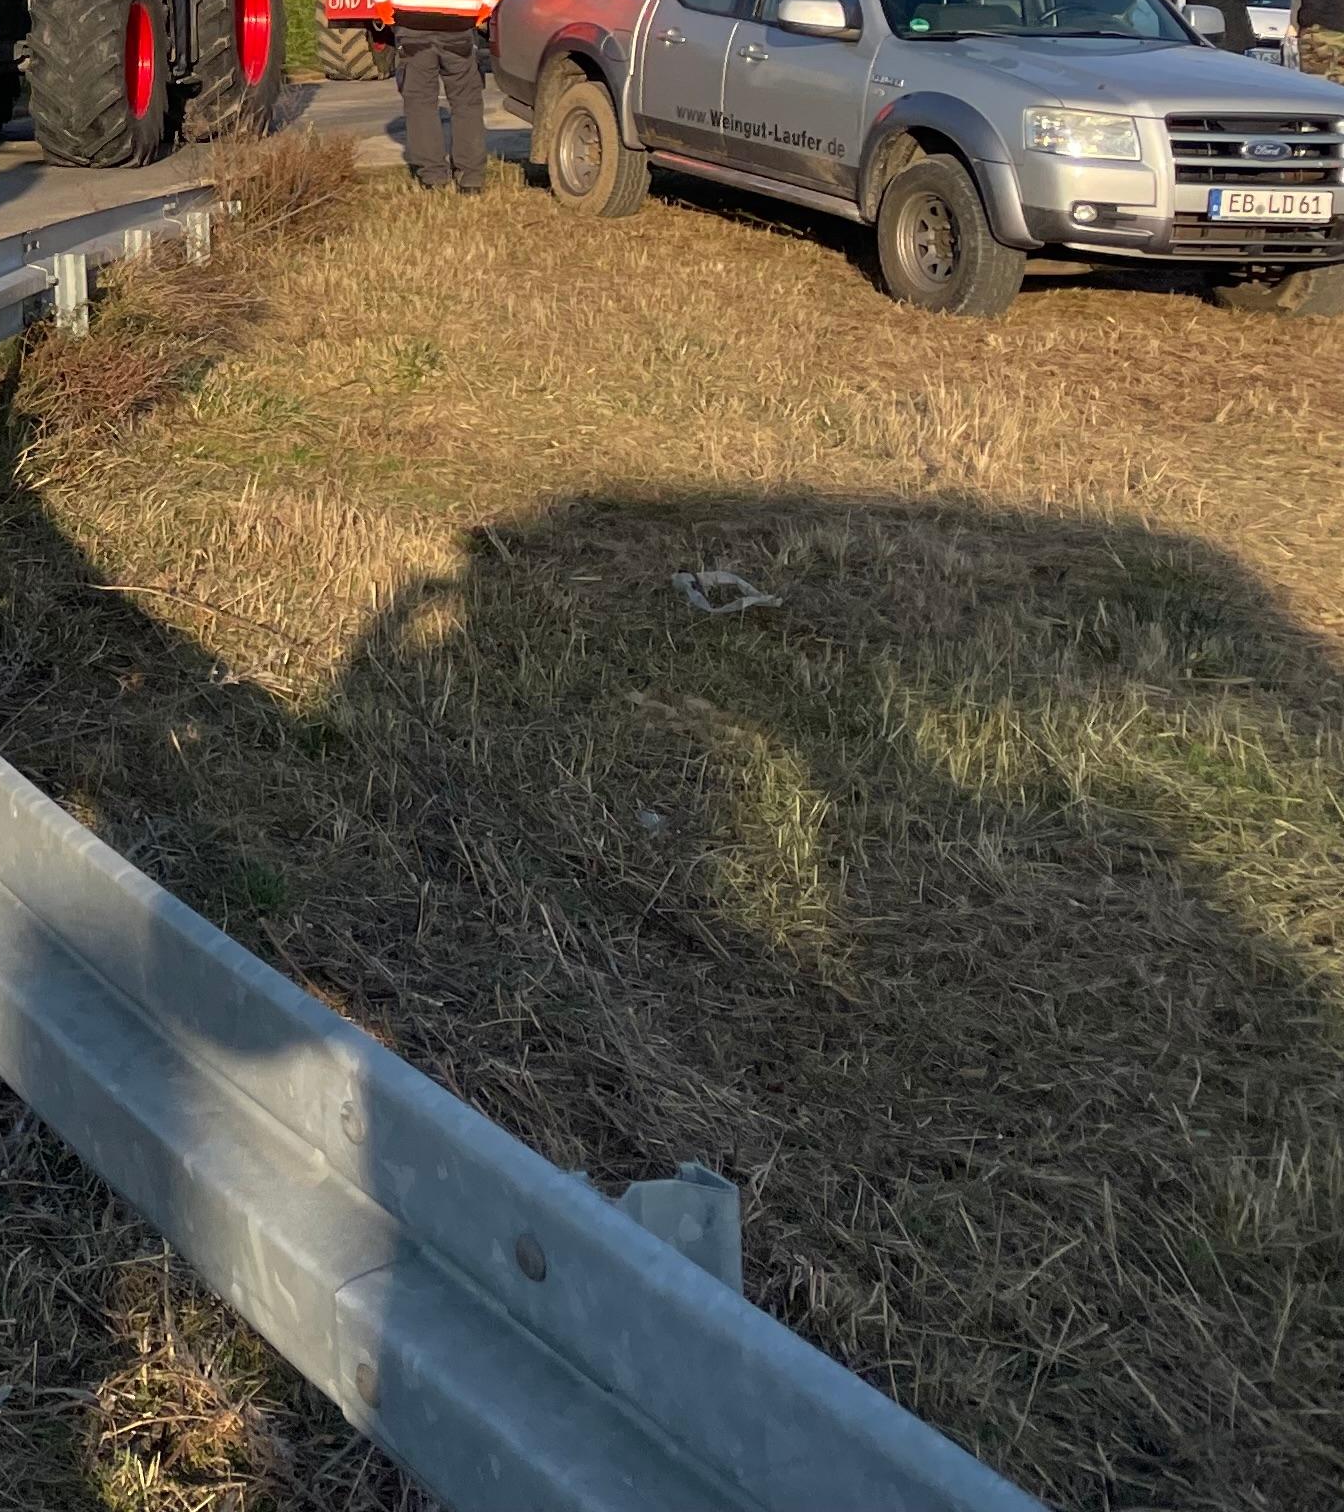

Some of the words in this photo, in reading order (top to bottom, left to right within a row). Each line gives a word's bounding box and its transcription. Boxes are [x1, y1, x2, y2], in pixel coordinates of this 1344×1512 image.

[676, 105, 846, 159] www.Weingut-Laufer.de
[1254, 144, 1281, 156] Ford
[1229, 194, 1254, 213] EB
[1268, 194, 1294, 214] LD
[1299, 195, 1322, 215] 61
